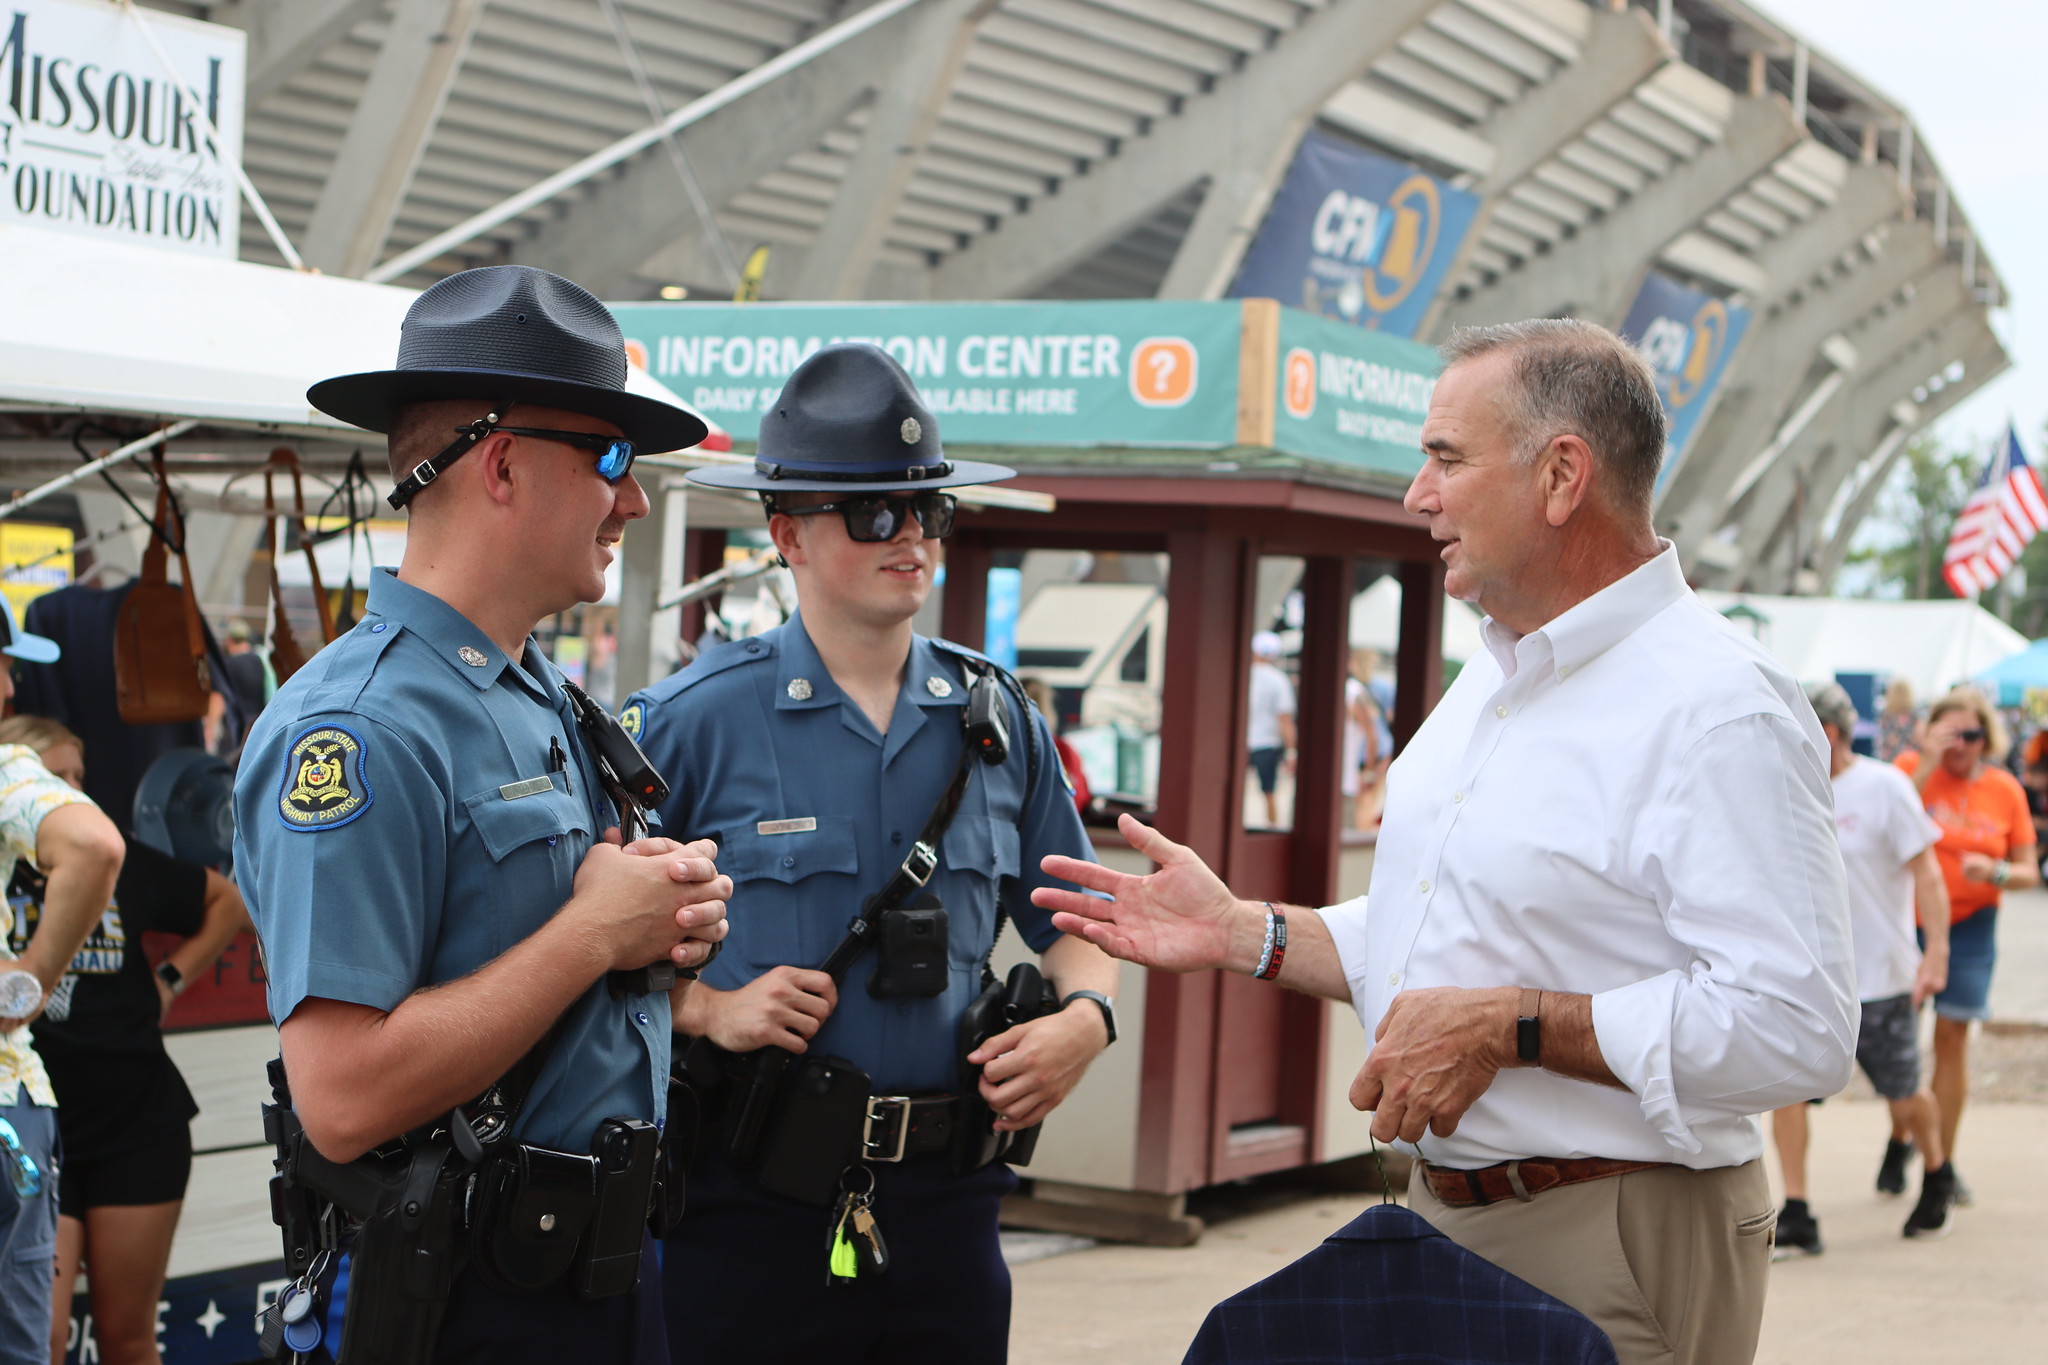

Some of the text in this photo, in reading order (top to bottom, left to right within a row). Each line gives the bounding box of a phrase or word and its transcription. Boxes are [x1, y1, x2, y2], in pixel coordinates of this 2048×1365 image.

[956, 334, 1122, 378] CENTER
[694, 386, 757, 413] DAILY
[1016, 388, 1078, 414] HERE
[293, 731, 358, 756] MISSOURI STATE
[281, 796, 360, 822] HIGHWAY PATROL
